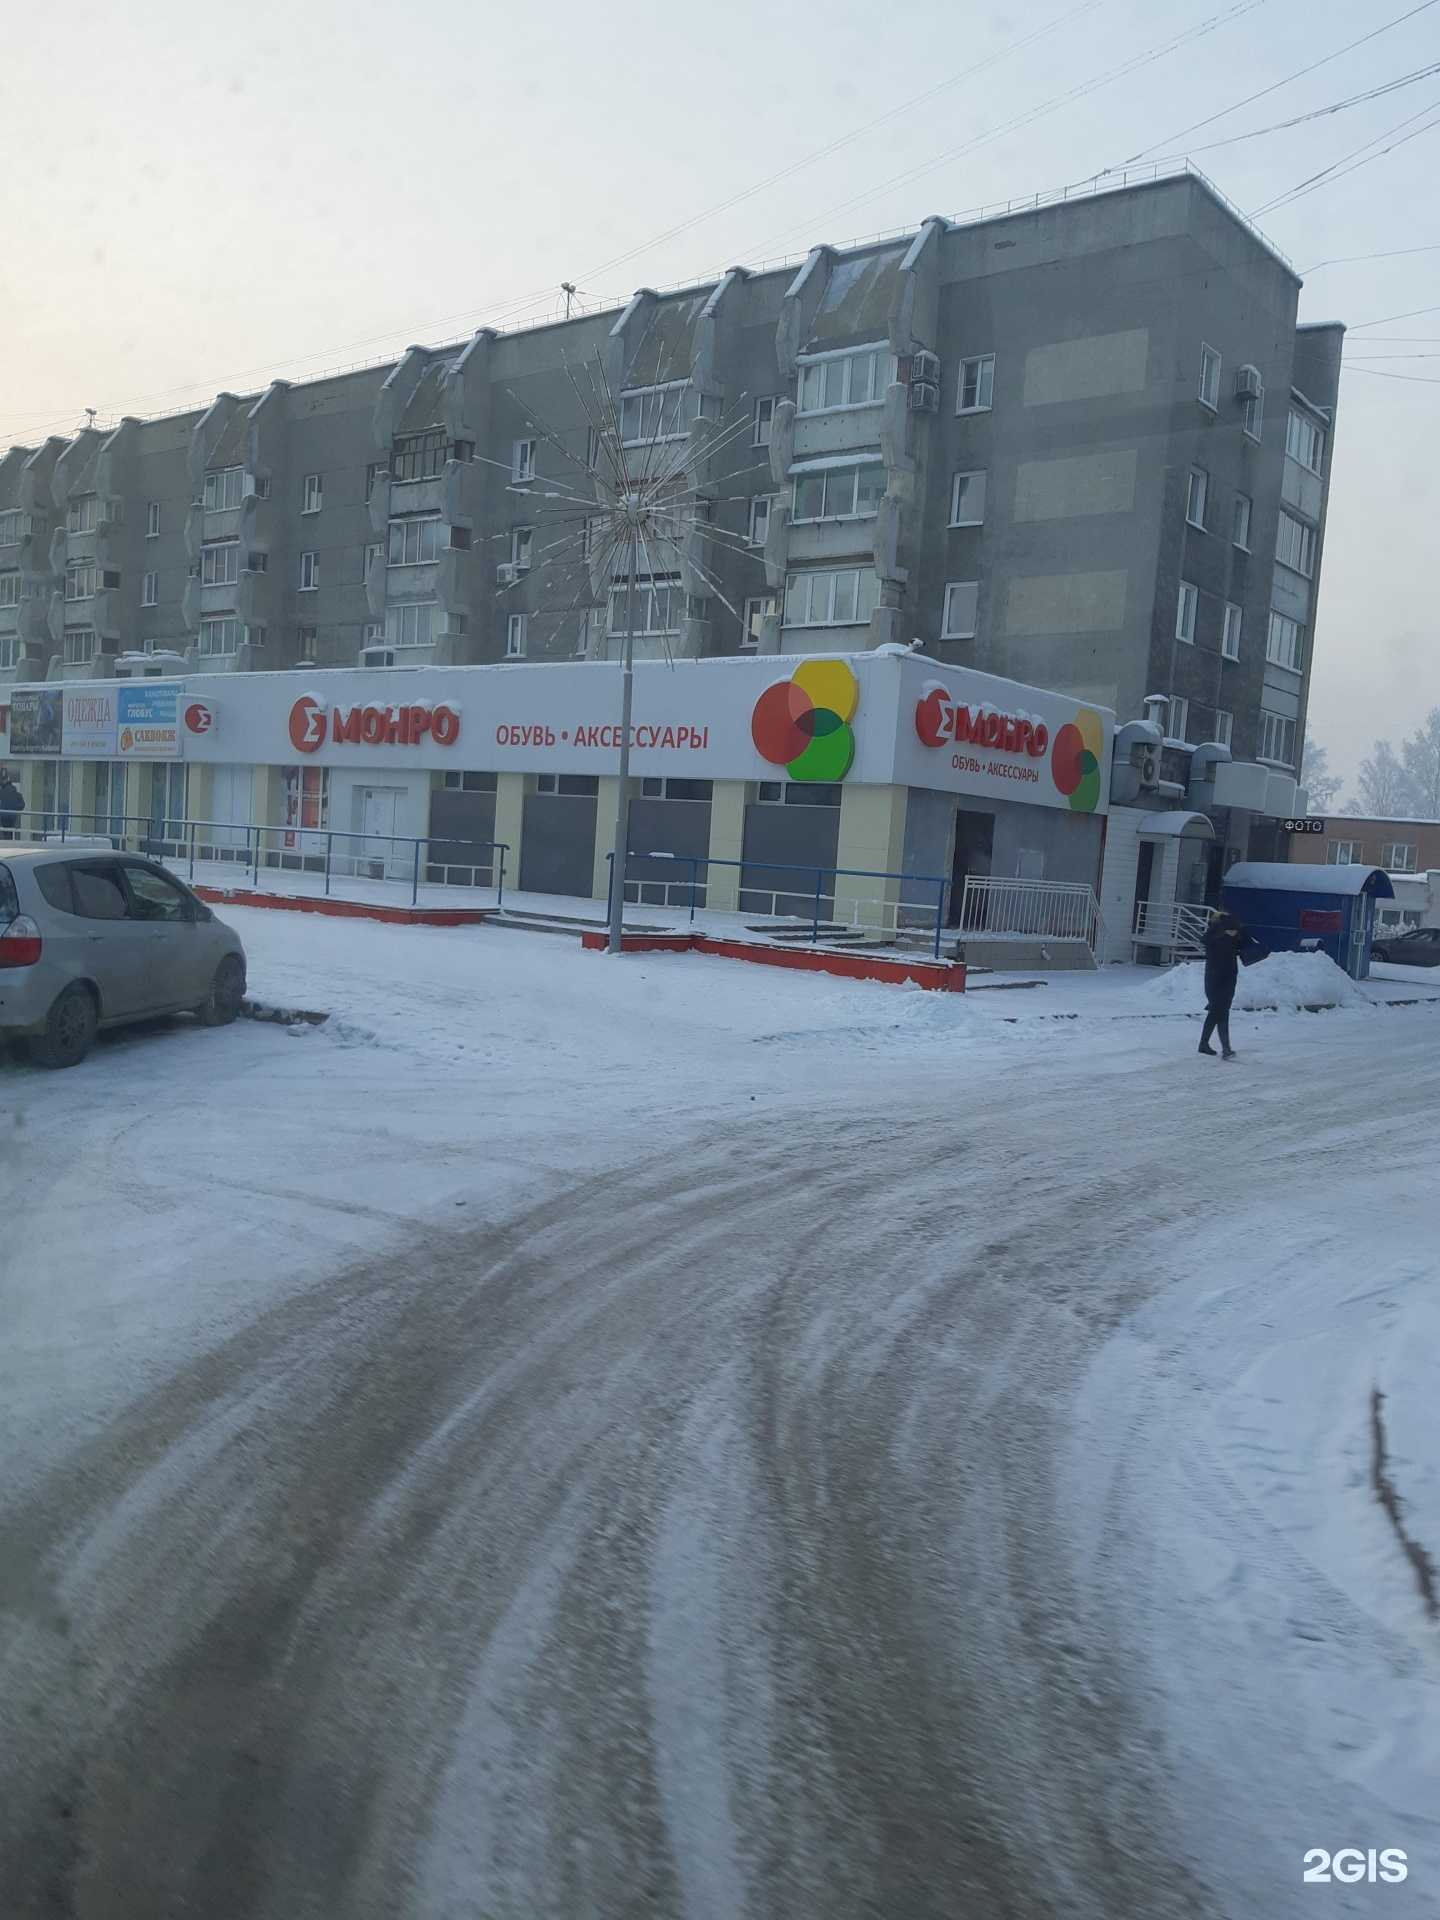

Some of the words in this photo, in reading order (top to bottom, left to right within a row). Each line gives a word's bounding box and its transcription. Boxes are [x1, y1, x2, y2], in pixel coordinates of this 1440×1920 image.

[68, 697, 112, 728] ОДЕЖДА
[332, 704, 460, 746] МОНРО
[496, 725, 556, 746] ОБУВЬ
[954, 705, 1049, 758] МОНРО
[951, 754, 981, 772] ОБУВЬ
[987, 761, 1040, 783] АКСЕССУАРЫ
[1284, 820, 1322, 832] ФОТО
